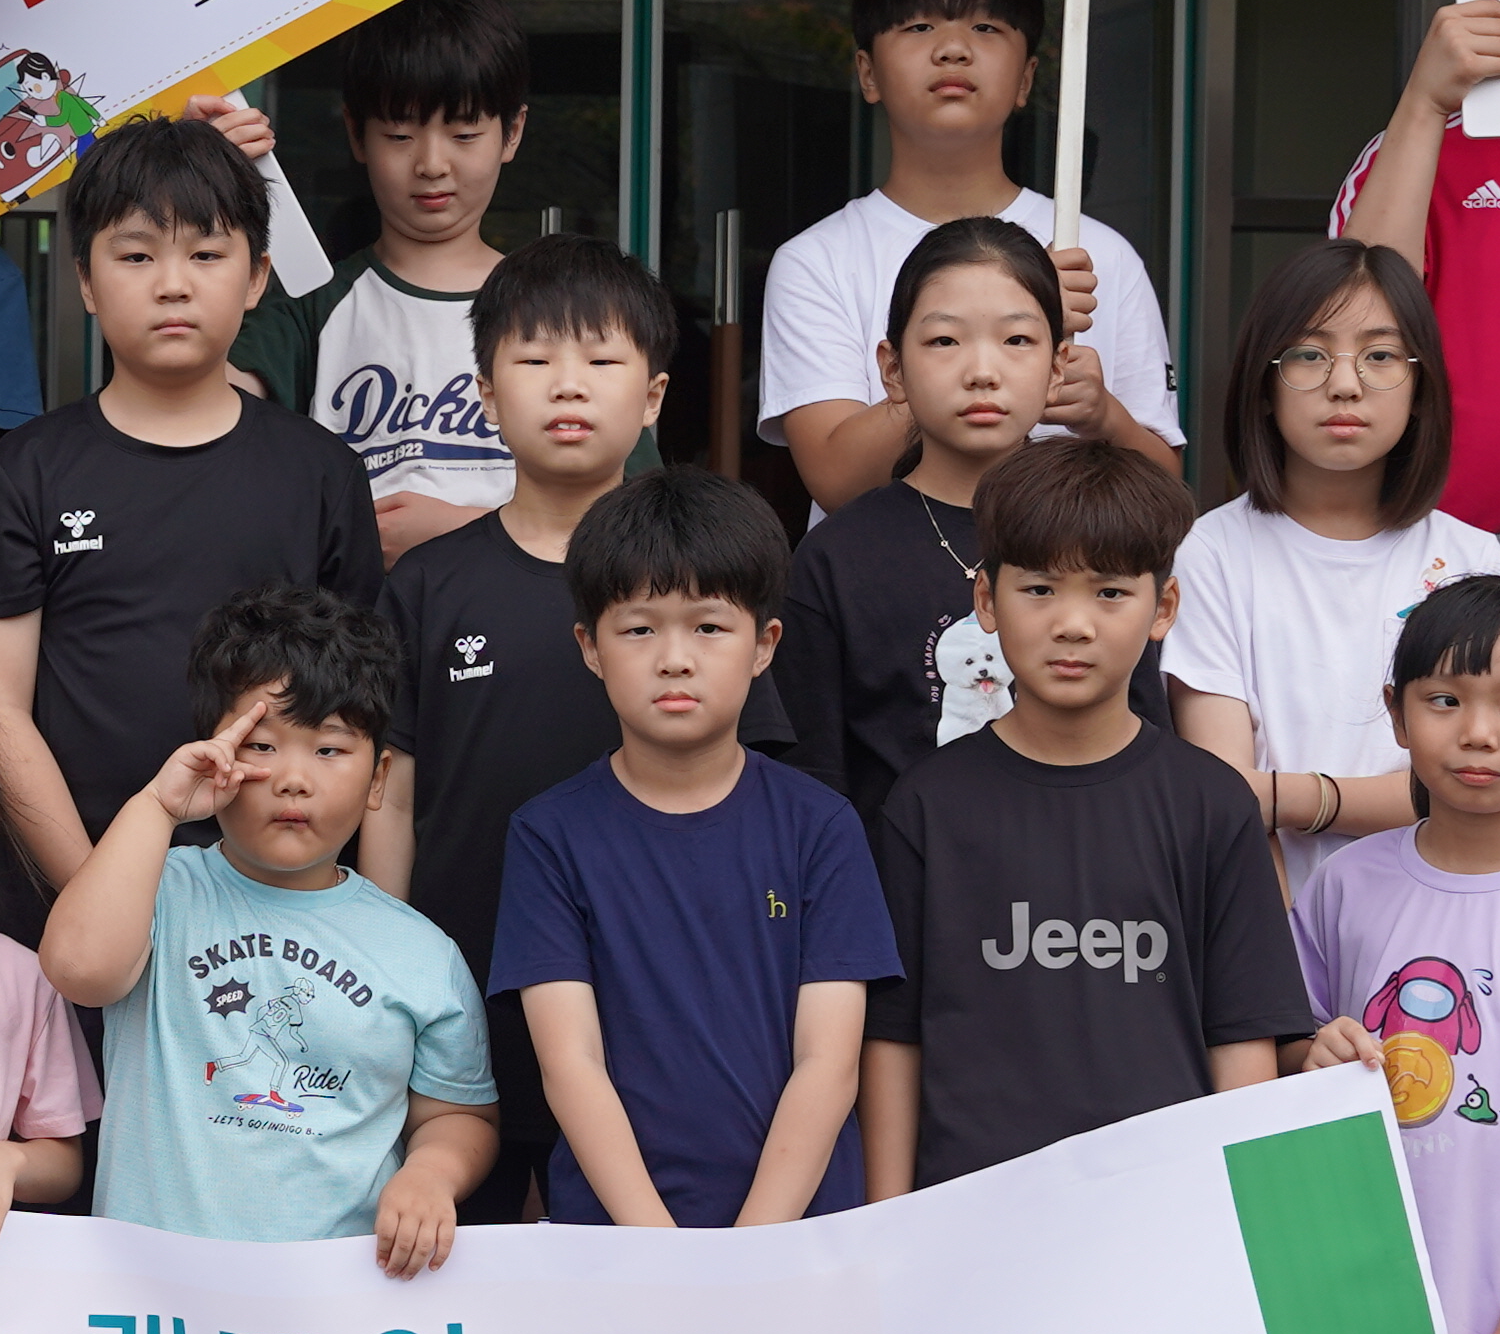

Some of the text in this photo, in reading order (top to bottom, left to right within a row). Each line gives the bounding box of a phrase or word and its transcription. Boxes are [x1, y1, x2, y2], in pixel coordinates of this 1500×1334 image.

[363, 451, 395, 471] INCE
[53, 535, 103, 555] hummel
[924, 630, 939, 666] HAPPY
[449, 660, 495, 683] hummel
[930, 685, 940, 703] YOU
[981, 901, 1169, 983] Jeep
[187, 933, 374, 1009] SKATE BOARD
[215, 987, 244, 1008] SPEED
[292, 1064, 347, 1093] Ride!
